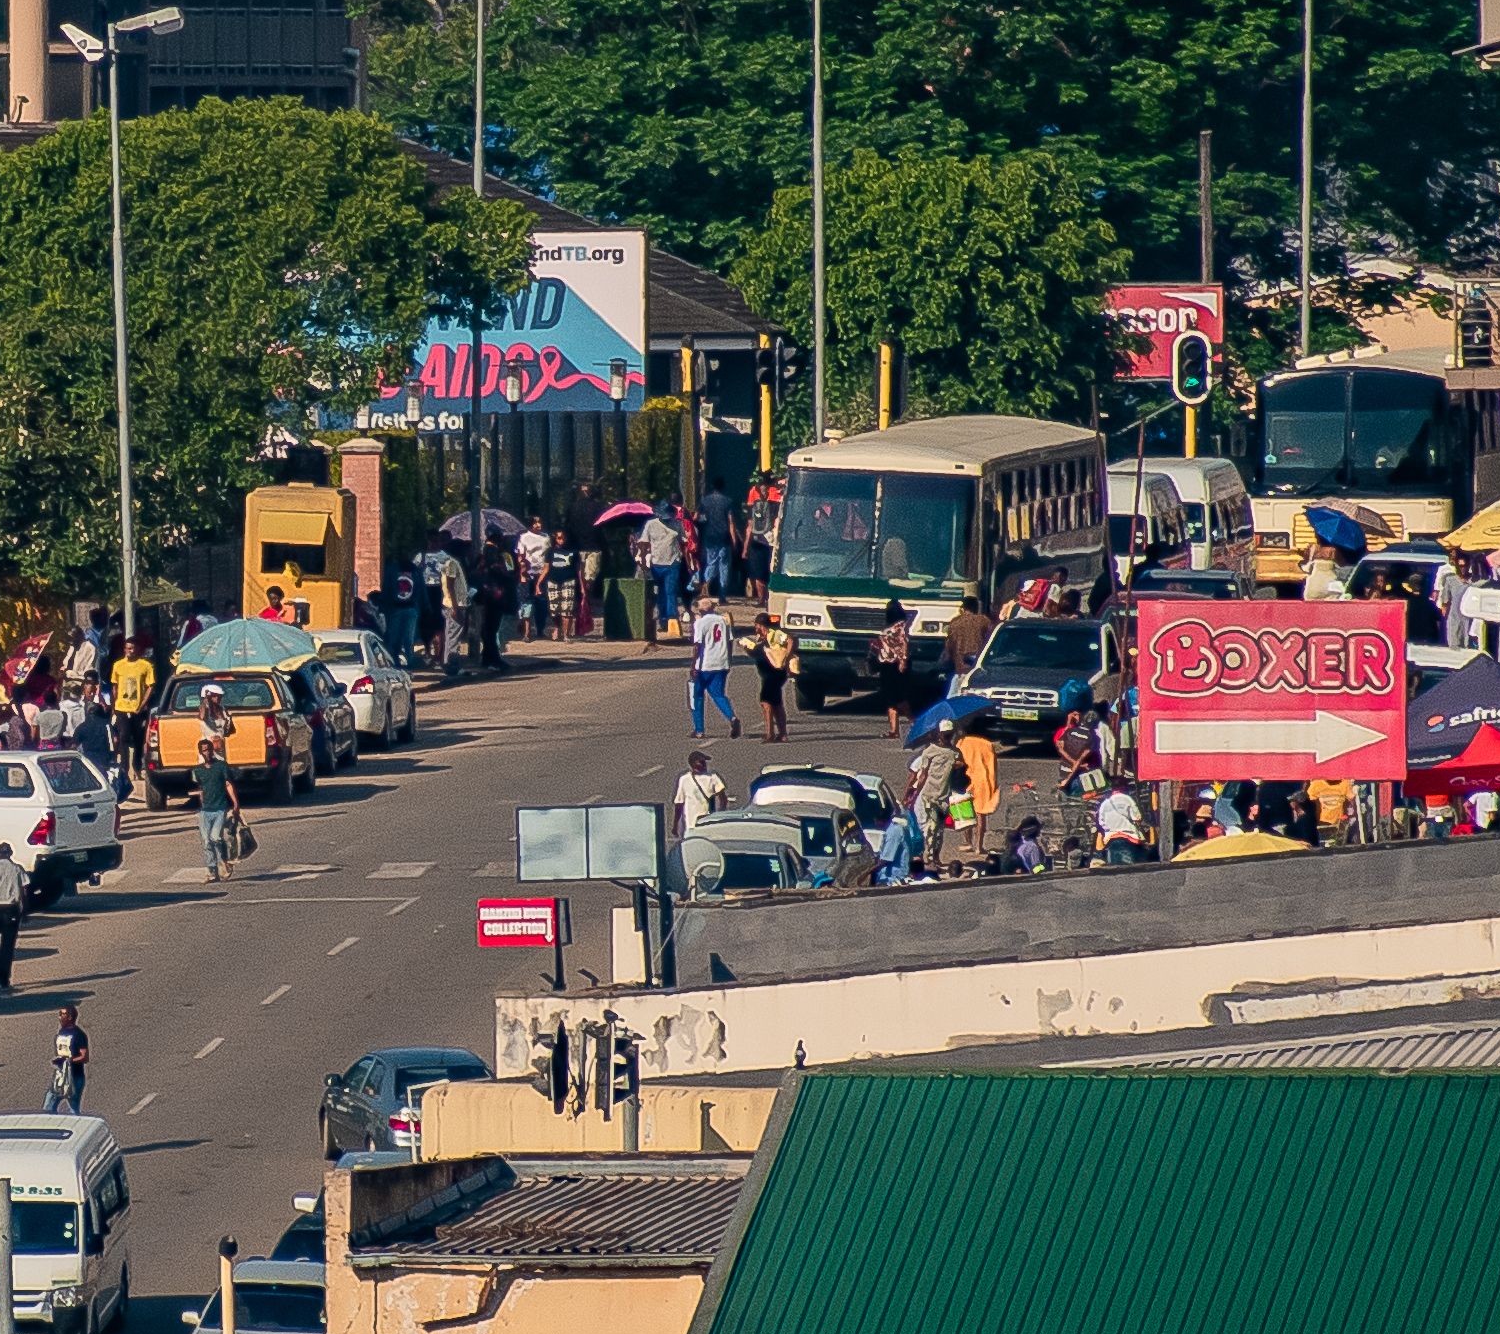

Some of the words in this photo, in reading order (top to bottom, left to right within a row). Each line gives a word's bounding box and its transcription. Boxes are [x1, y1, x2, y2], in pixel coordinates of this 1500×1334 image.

[418, 343, 535, 399] AIDS
[1150, 619, 1395, 697] BOXER
[27, 1186, 63, 1196] 8:35
